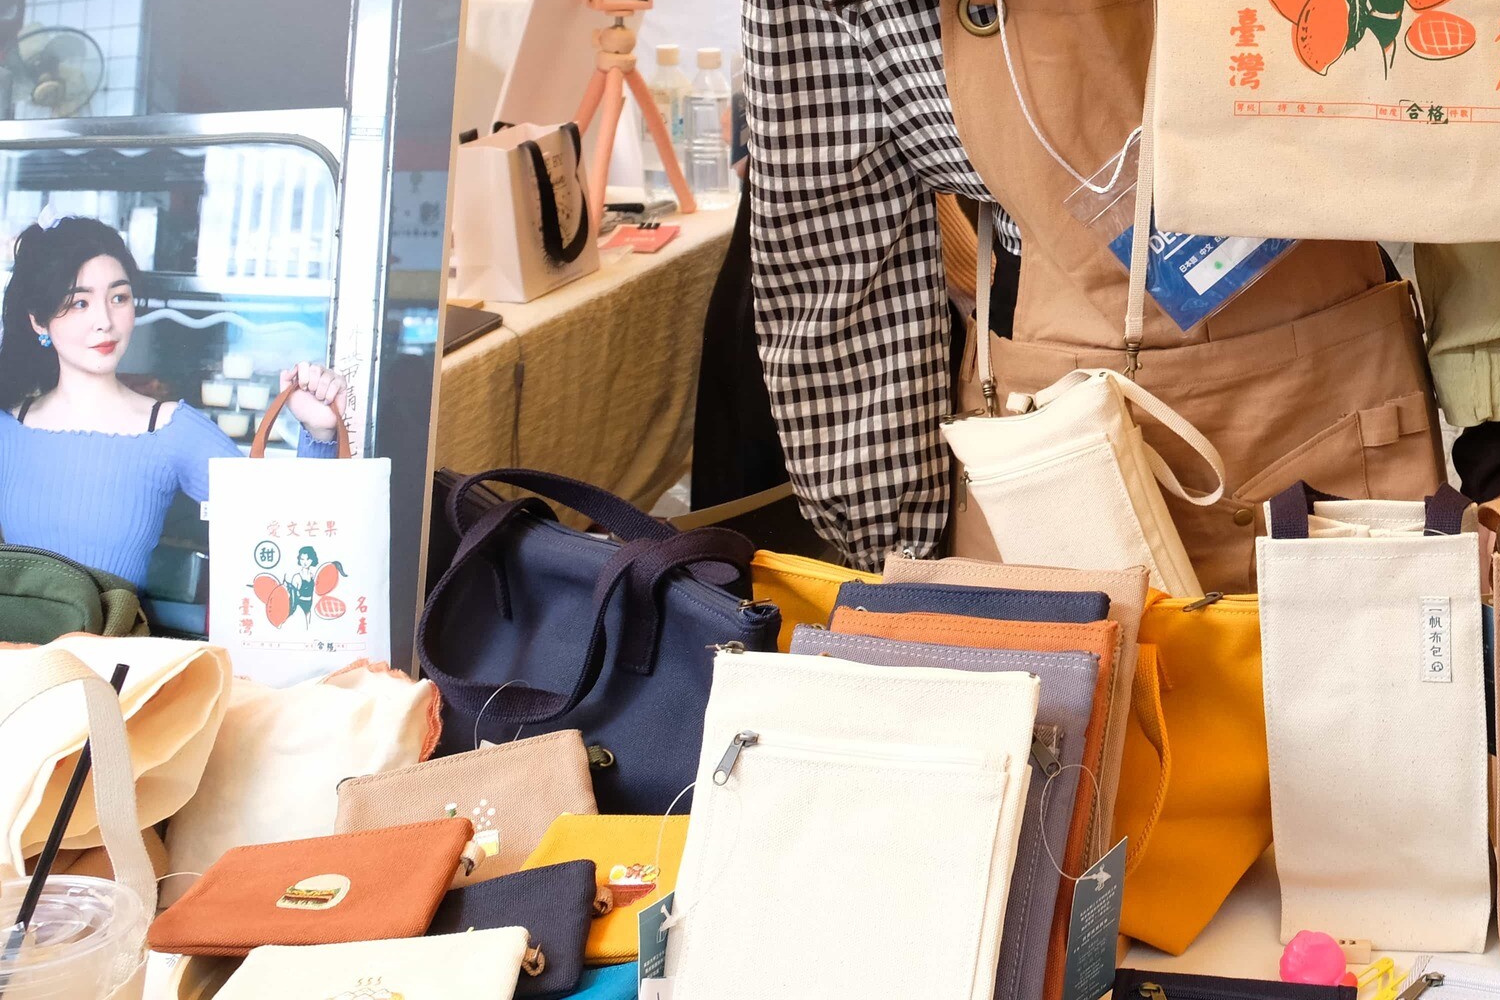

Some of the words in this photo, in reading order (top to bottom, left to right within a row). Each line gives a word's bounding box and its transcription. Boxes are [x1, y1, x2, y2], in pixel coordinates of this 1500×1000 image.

[1229, 8, 1267, 91] 臺灣
[1405, 103, 1445, 122] 合格
[1429, 608, 1443, 657] 一帆布包
